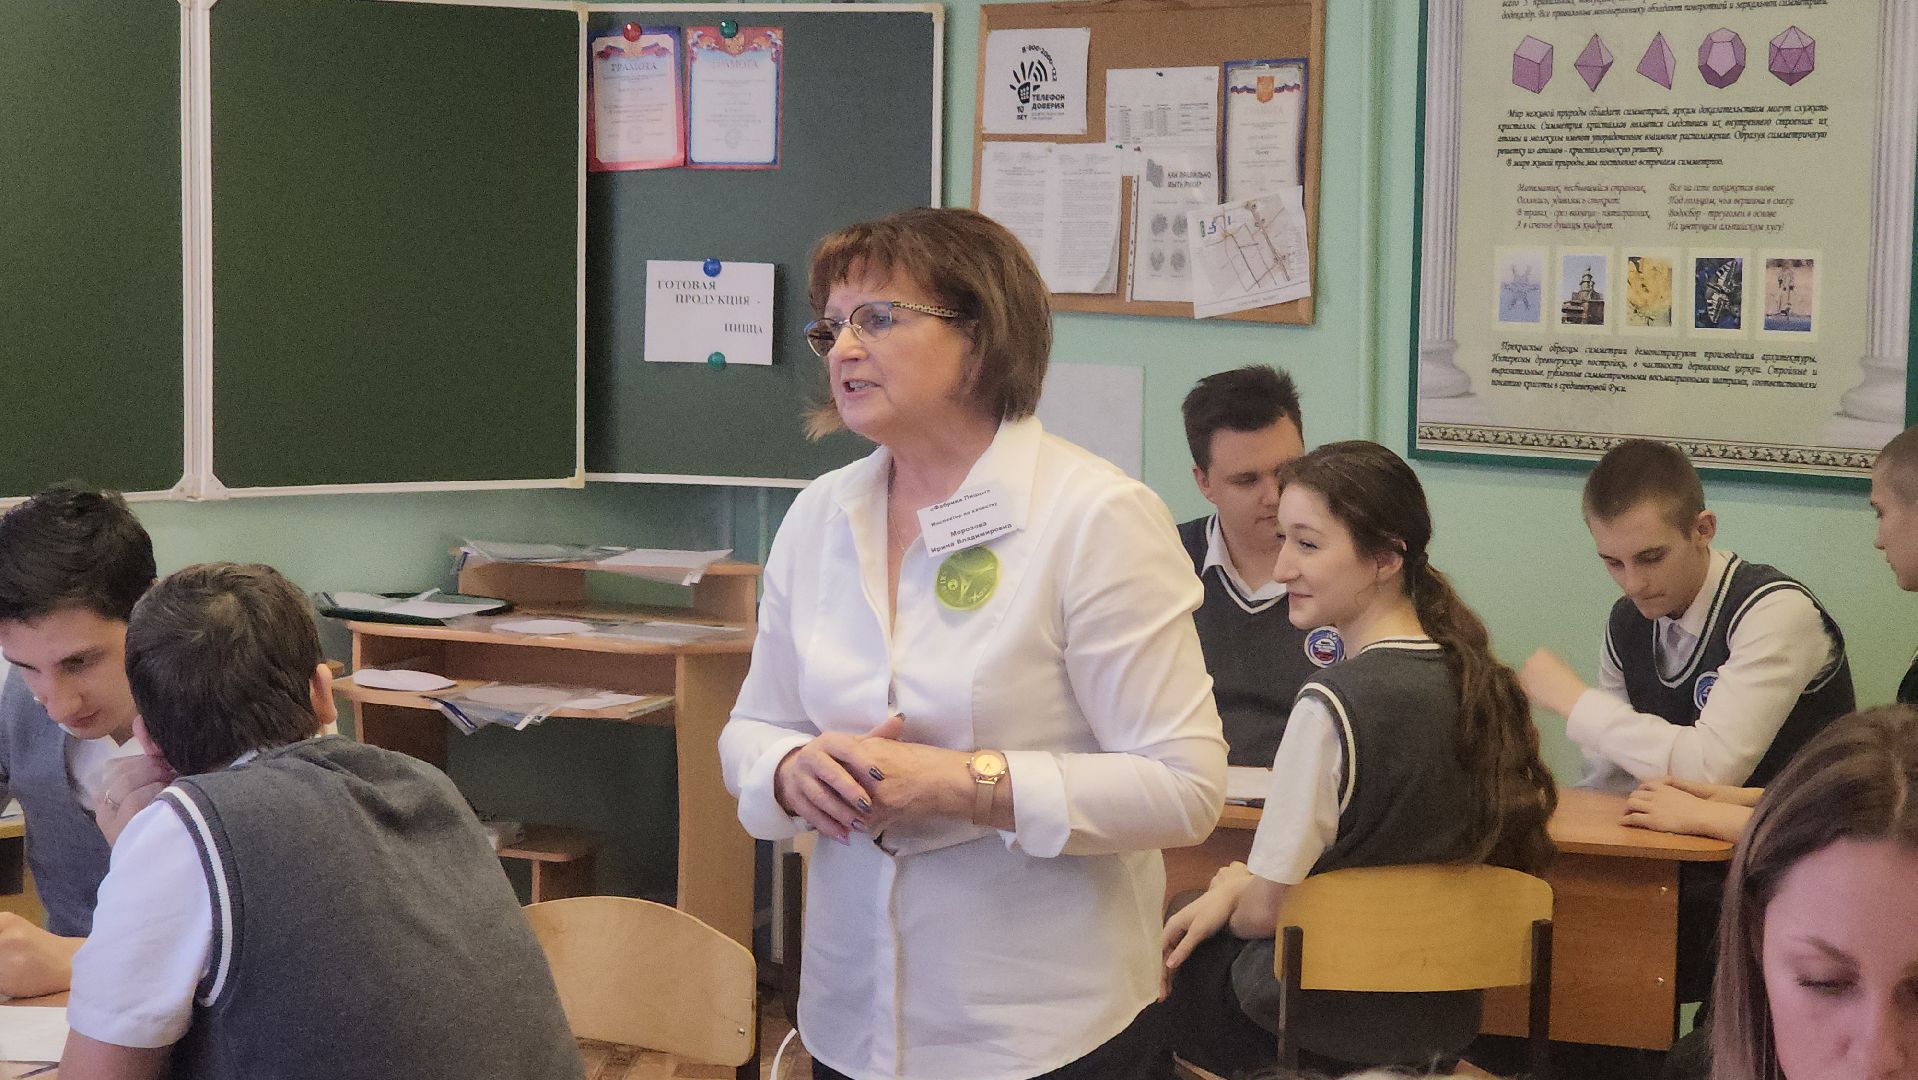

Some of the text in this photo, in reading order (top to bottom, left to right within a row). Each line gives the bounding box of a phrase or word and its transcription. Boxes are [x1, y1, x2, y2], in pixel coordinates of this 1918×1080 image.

[1017, 105, 1024, 113] 10
[1032, 102, 1065, 110] ДОВЕРИЯ
[657, 280, 716, 290] ГОТОВАЯ
[675, 293, 750, 305] ПРОДУКЦИЯ
[724, 323, 764, 334] ПИЦЦА
[950, 521, 988, 537] Морозова
[931, 523, 1013, 553] Ирина Владимировна
